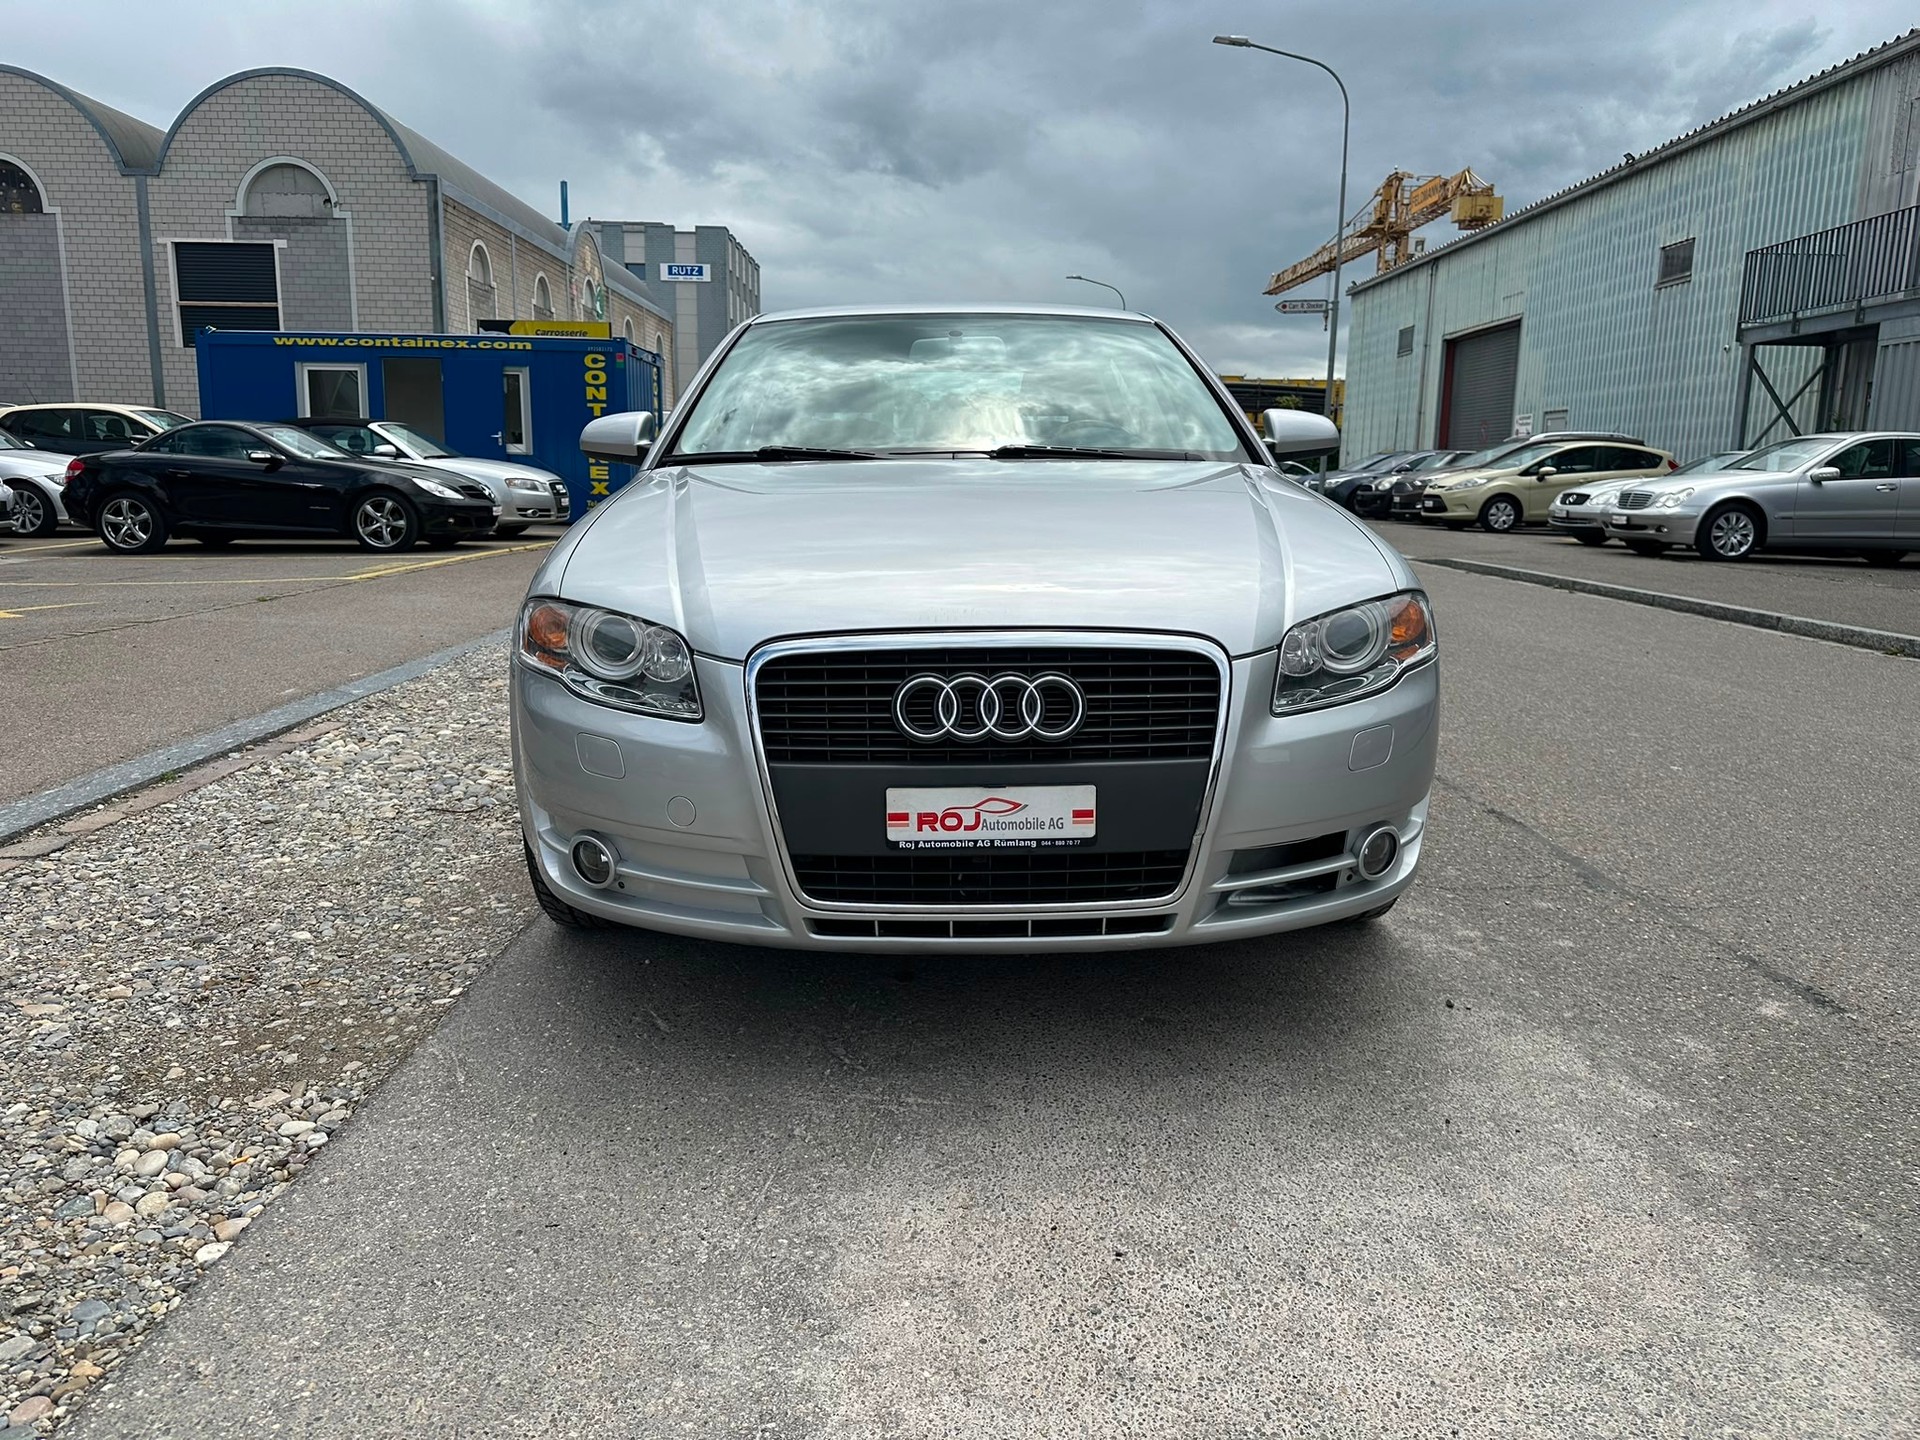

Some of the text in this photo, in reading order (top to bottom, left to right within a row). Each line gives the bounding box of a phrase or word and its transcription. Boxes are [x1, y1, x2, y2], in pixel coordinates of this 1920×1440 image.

[672, 266, 699, 275] RUTZ
[535, 329, 589, 337] Carrosserie
[273, 337, 532, 350] www.containex.com
[584, 353, 611, 496] CONTEX
[916, 811, 1064, 832] ROJ Automobile AG
[899, 841, 915, 849] Roj
[918, 840, 974, 848] Automobile
[977, 839, 991, 847] AG
[994, 839, 1037, 848] Rümlang
